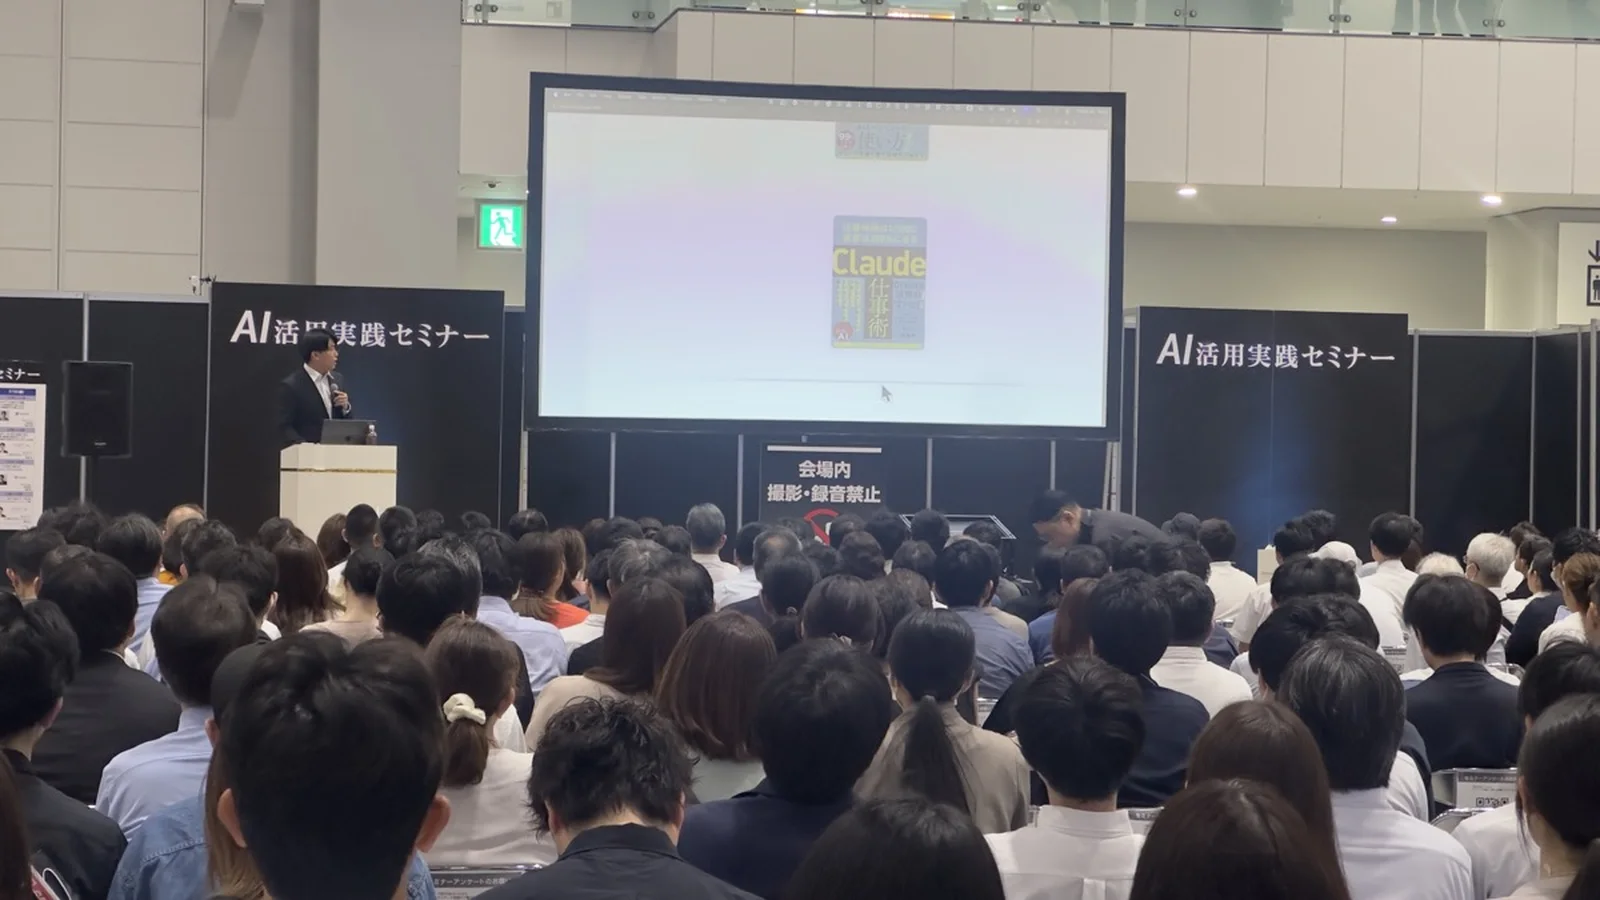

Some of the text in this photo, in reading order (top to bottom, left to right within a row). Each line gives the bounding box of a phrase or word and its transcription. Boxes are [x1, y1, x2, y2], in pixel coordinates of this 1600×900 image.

[833, 247, 926, 277] Claude
[1156, 333, 1396, 369] AI活用実践セミナー
[798, 459, 851, 479] 会場内
[767, 483, 881, 503] 撮影・録音禁止
